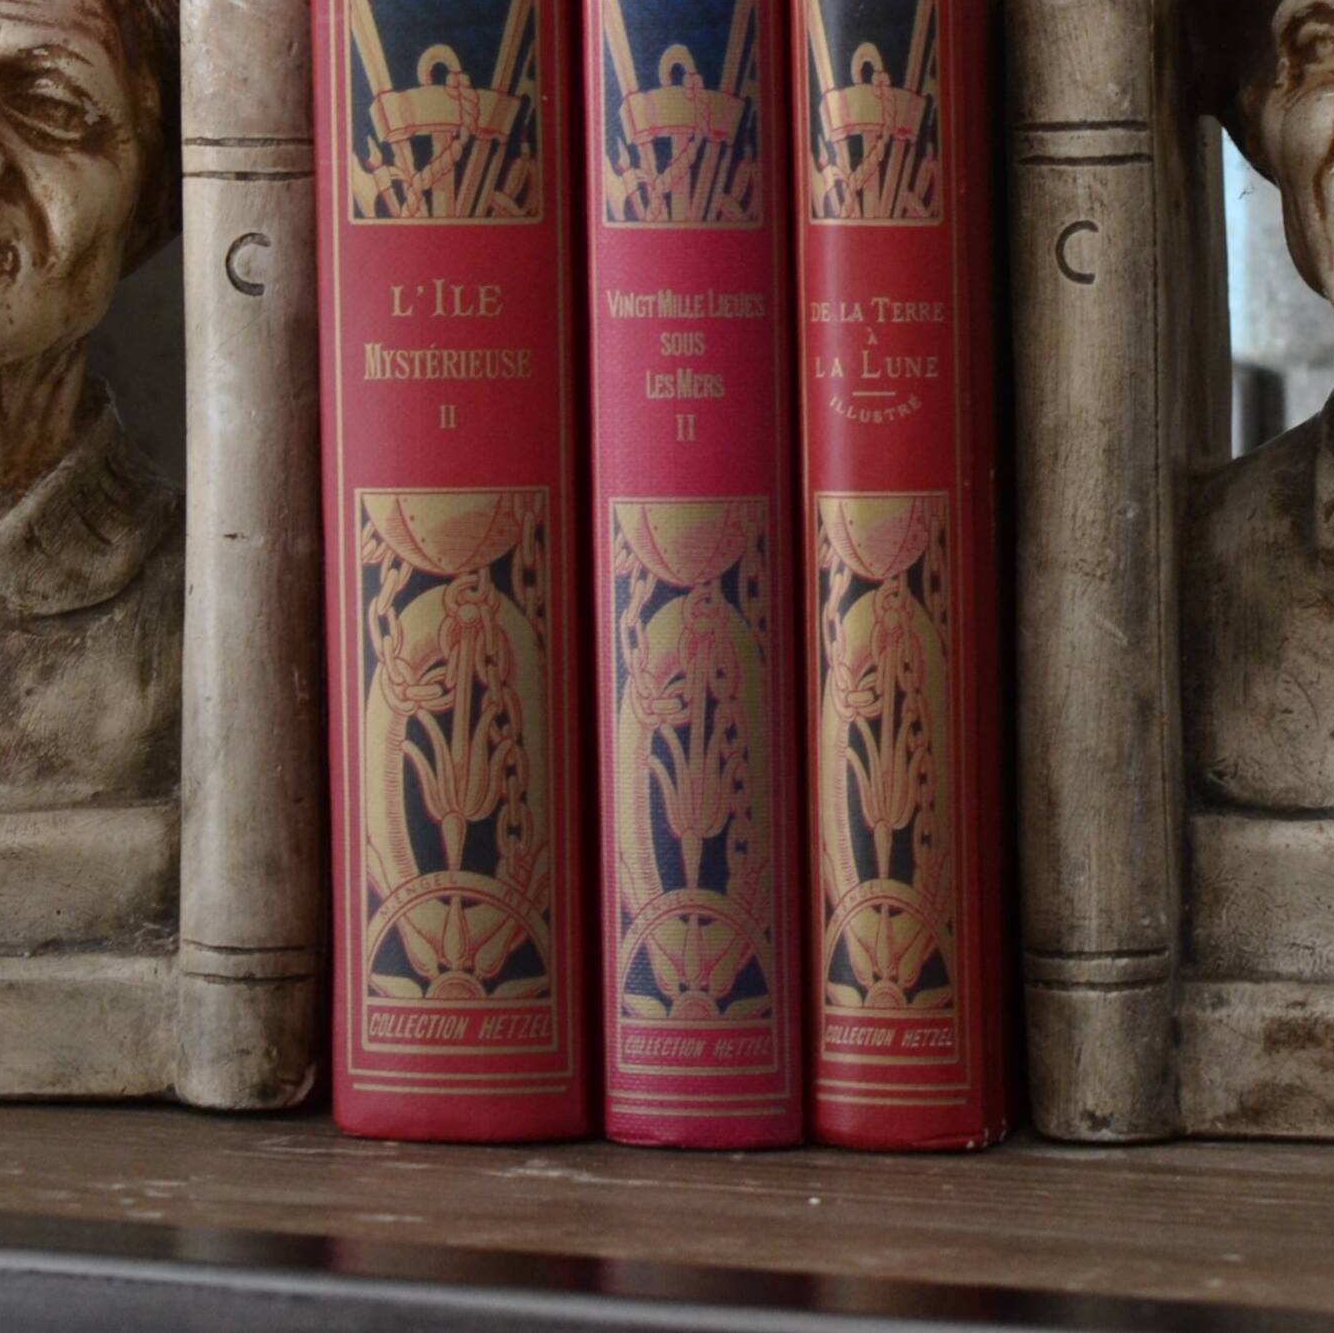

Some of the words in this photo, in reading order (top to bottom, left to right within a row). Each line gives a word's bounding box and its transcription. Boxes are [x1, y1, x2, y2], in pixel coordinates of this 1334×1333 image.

[606, 289, 657, 318] VINGT
[657, 288, 705, 318] MILLE
[708, 288, 764, 318] LIEUES
[810, 302, 830, 323] DE
[839, 302, 864, 323] LA
[871, 296, 945, 323] TERRE
[363, 343, 532, 380] MYSTÉRIEUSE
[815, 356, 844, 378] LA
[861, 349, 939, 378] LUNE
[646, 369, 675, 399] LES
[676, 367, 726, 399] MERS
[439, 404, 457, 429] II
[675, 413, 697, 442] II
[369, 1012, 469, 1040] COLLECTION
[479, 1014, 554, 1040] HETZEL
[825, 1025, 896, 1047] COLLECTION
